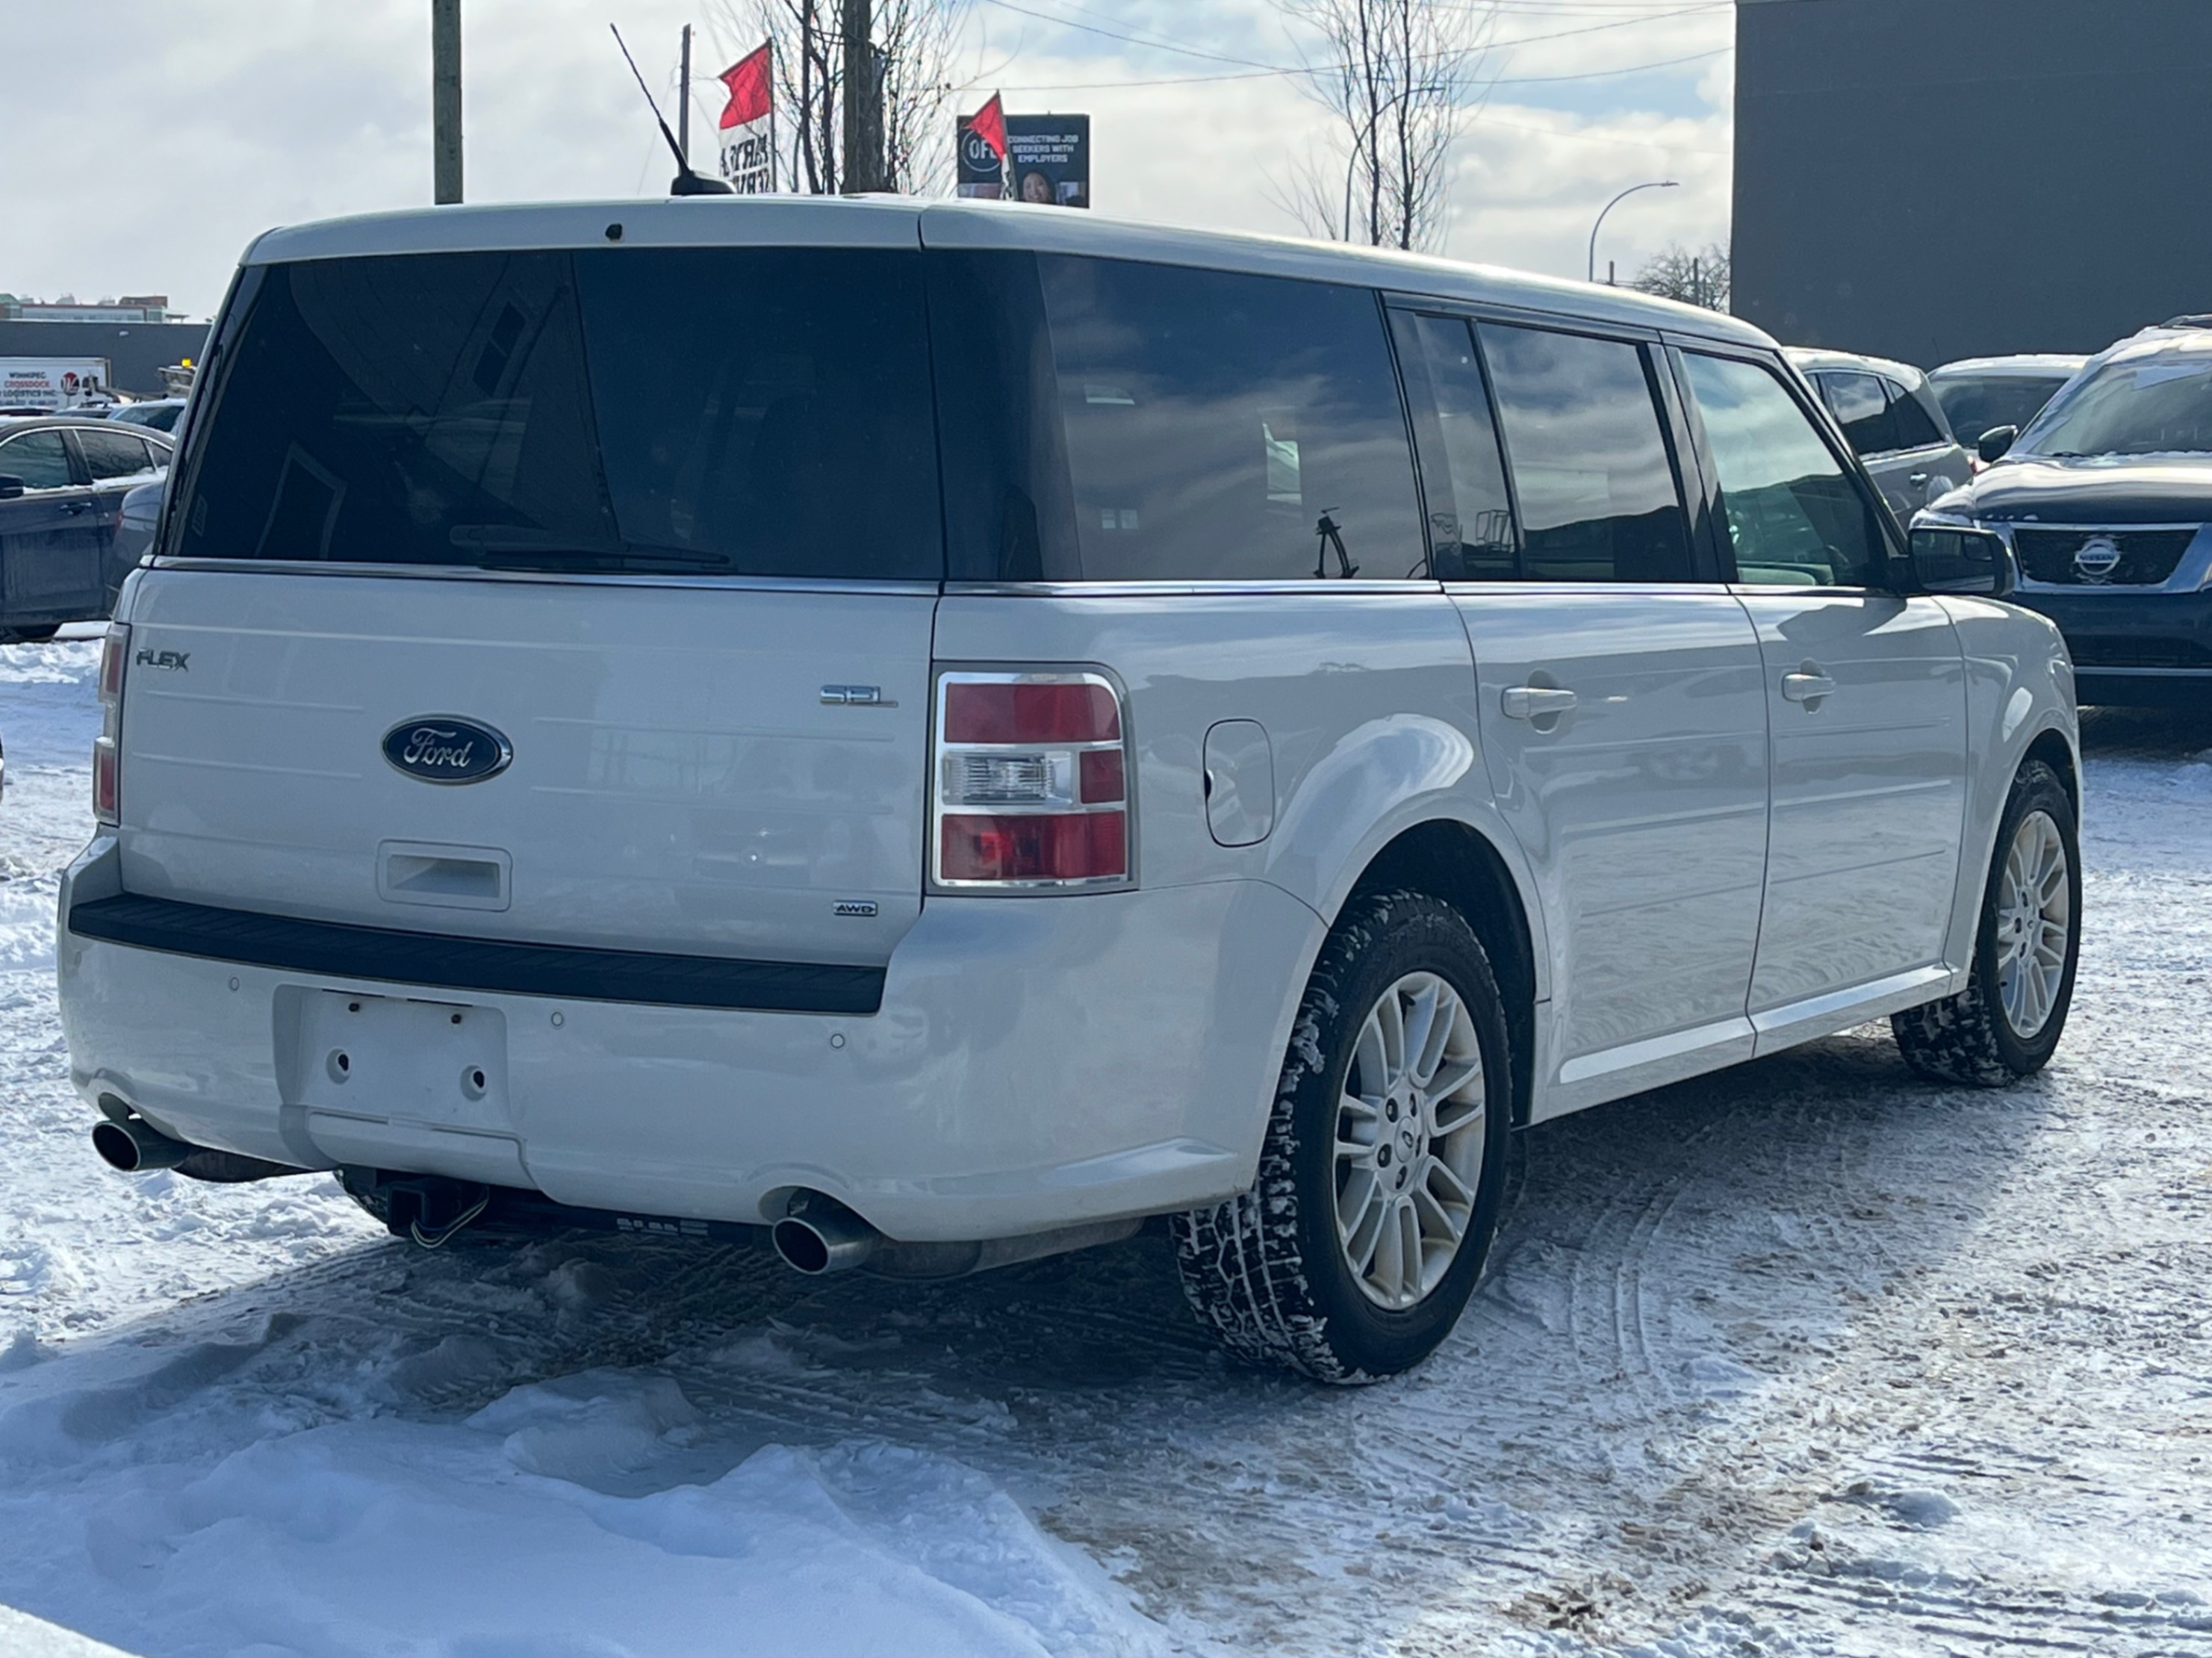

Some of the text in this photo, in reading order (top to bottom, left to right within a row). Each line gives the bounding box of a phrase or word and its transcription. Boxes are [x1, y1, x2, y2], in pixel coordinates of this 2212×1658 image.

[1061, 134, 1079, 143] JOB
[1051, 144, 1074, 152] WITH
[1018, 155, 1068, 163] EMPLOYERS
[136, 647, 190, 671] FLEX
[820, 685, 899, 708] SEL
[403, 727, 473, 767] Ford
[836, 904, 874, 913] AWD
